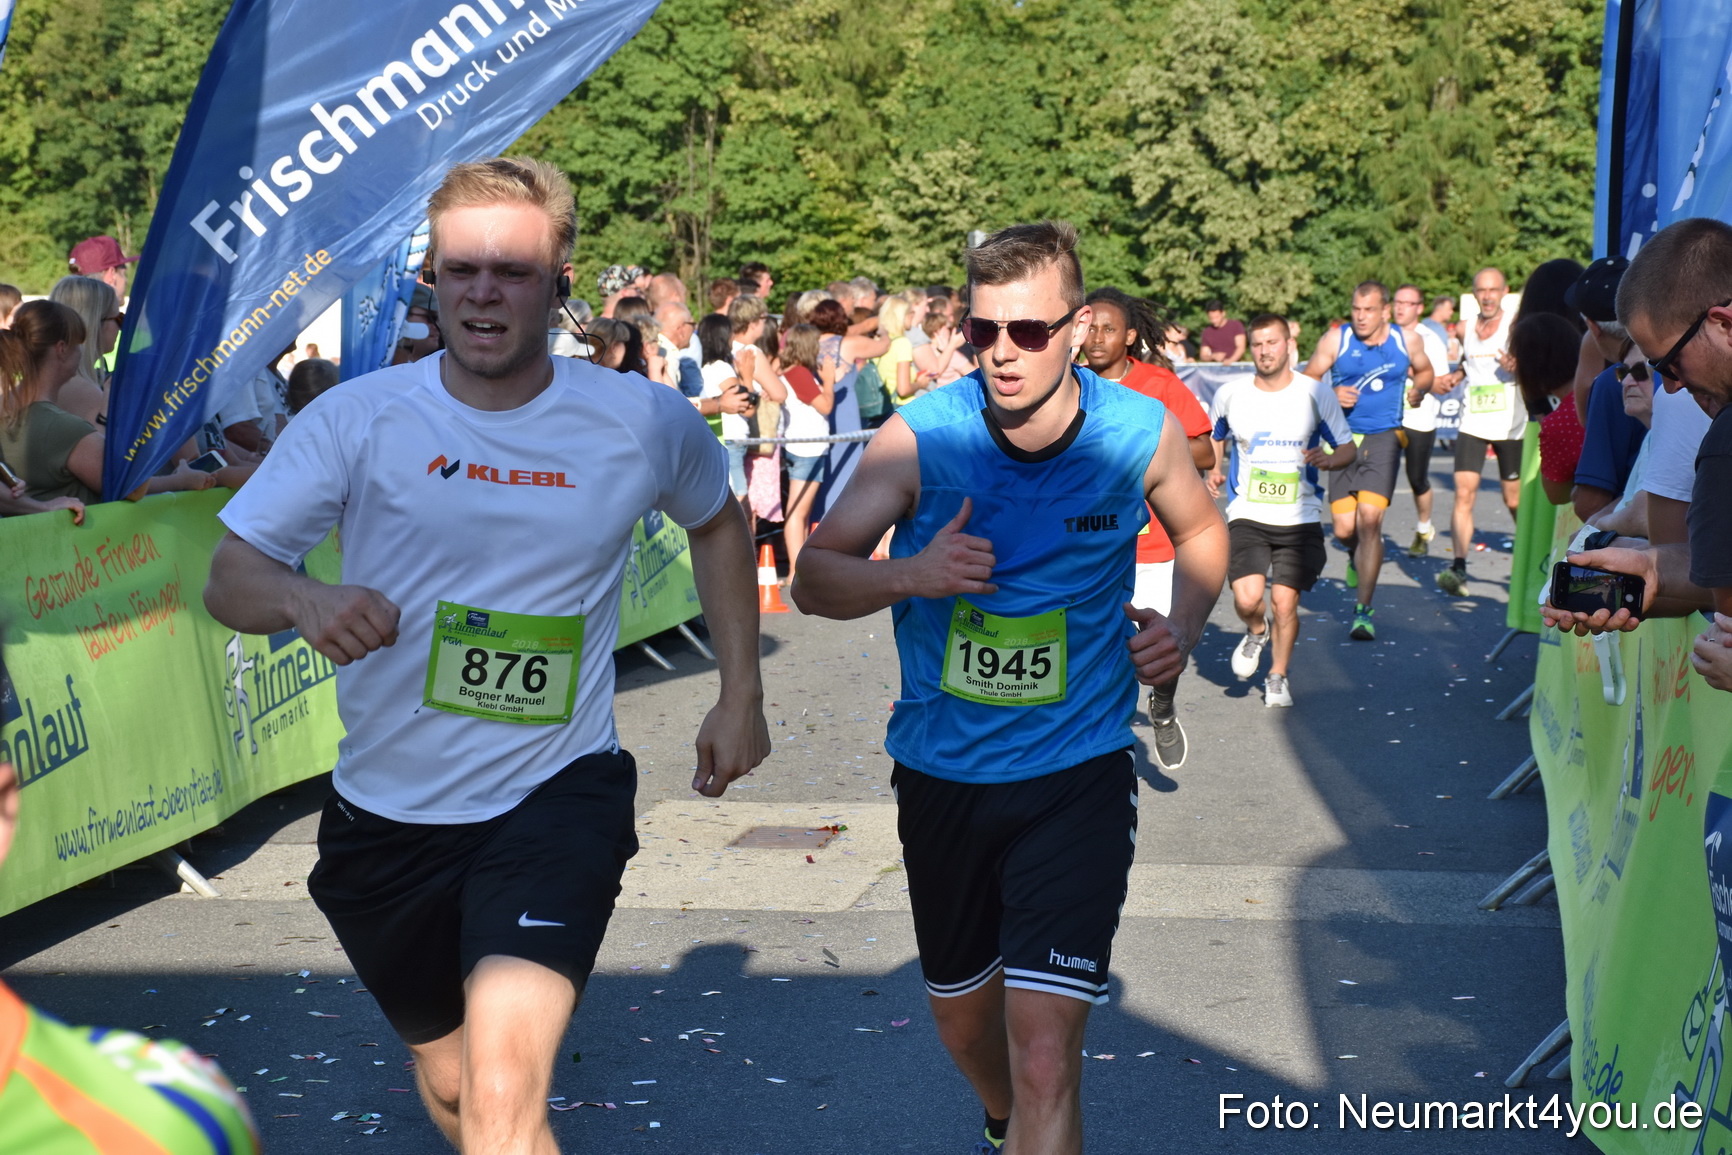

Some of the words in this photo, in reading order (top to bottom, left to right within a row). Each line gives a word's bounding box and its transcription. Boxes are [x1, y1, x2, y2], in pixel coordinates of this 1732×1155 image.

[415, 60, 498, 131] Druck
[496, 10, 551, 64] und
[544, 0, 588, 20] M
[124, 249, 333, 462] www.frischmann-net.de
[1246, 431, 1304, 455] FORSTER
[467, 463, 576, 488] KLEBL
[1258, 481, 1287, 496] 630
[1064, 514, 1119, 533] THULE
[25, 545, 99, 620] Gesunde
[95, 533, 162, 583] Firmen
[76, 603, 138, 663] laufen
[128, 563, 188, 636] länger!
[454, 622, 508, 639] firmenlauf
[963, 617, 999, 638] firmenlauf
[512, 639, 539, 650] 2018
[1003, 638, 1028, 647] 2018
[461, 648, 549, 693] 876
[959, 640, 1051, 680] 1945
[254, 647, 337, 717] firmen
[966, 675, 994, 690] Smith
[996, 682, 1038, 691] Dominik
[980, 688, 998, 697] Thule
[459, 686, 501, 702] Bogner
[504, 693, 545, 706] Manuel
[477, 701, 498, 710] Klebl
[500, 705, 524, 713] GmbH
[261, 696, 309, 743] neumarkt
[55, 760, 224, 862] www.firmenlauf-oberpfalz.de
[337, 801, 355, 821] DRI-FIT
[1049, 948, 1099, 972] hummel
